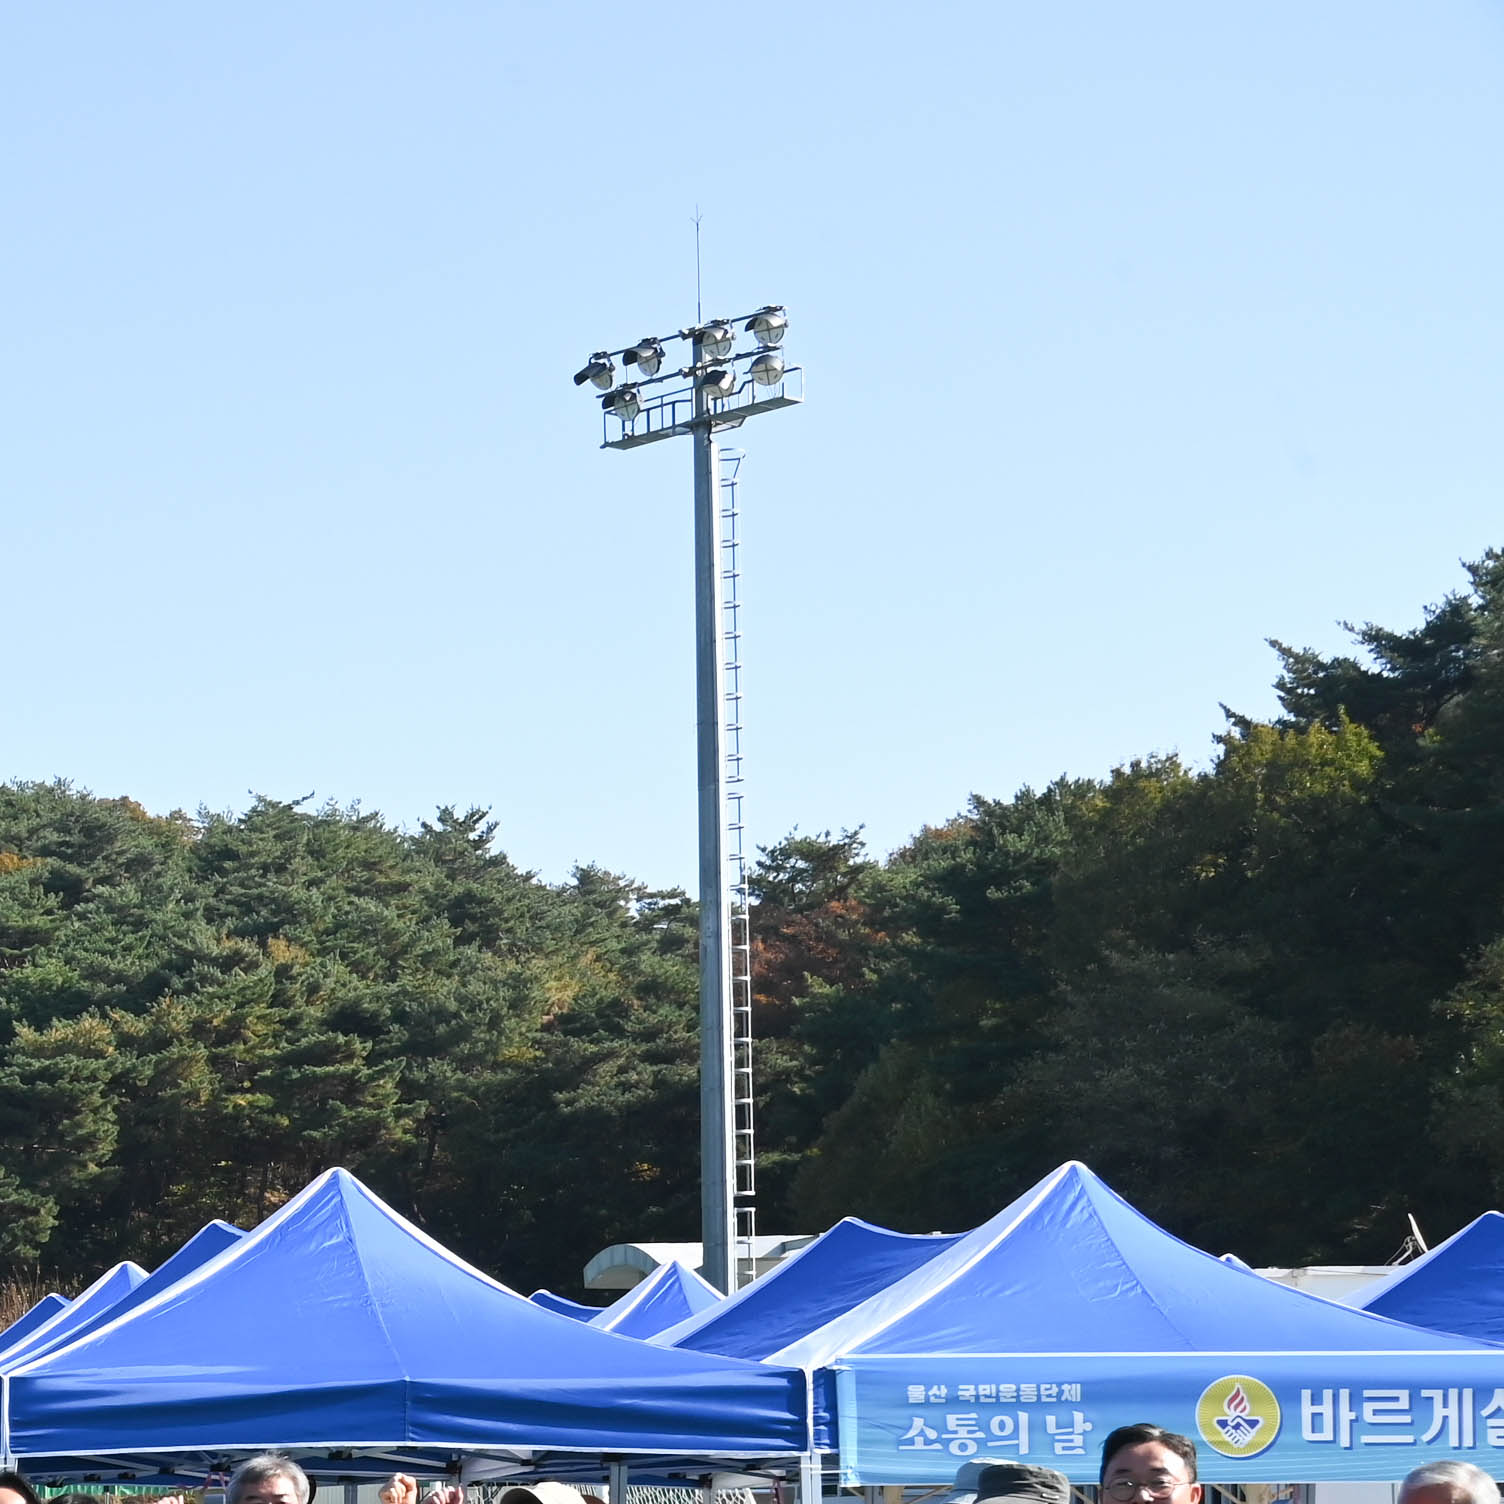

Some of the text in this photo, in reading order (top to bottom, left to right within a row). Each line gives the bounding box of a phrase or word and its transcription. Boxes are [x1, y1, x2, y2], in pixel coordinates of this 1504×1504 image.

[906, 1383, 1082, 1403] 울산 국민운동단체
[898, 1410, 1093, 1456] 소통의 날
